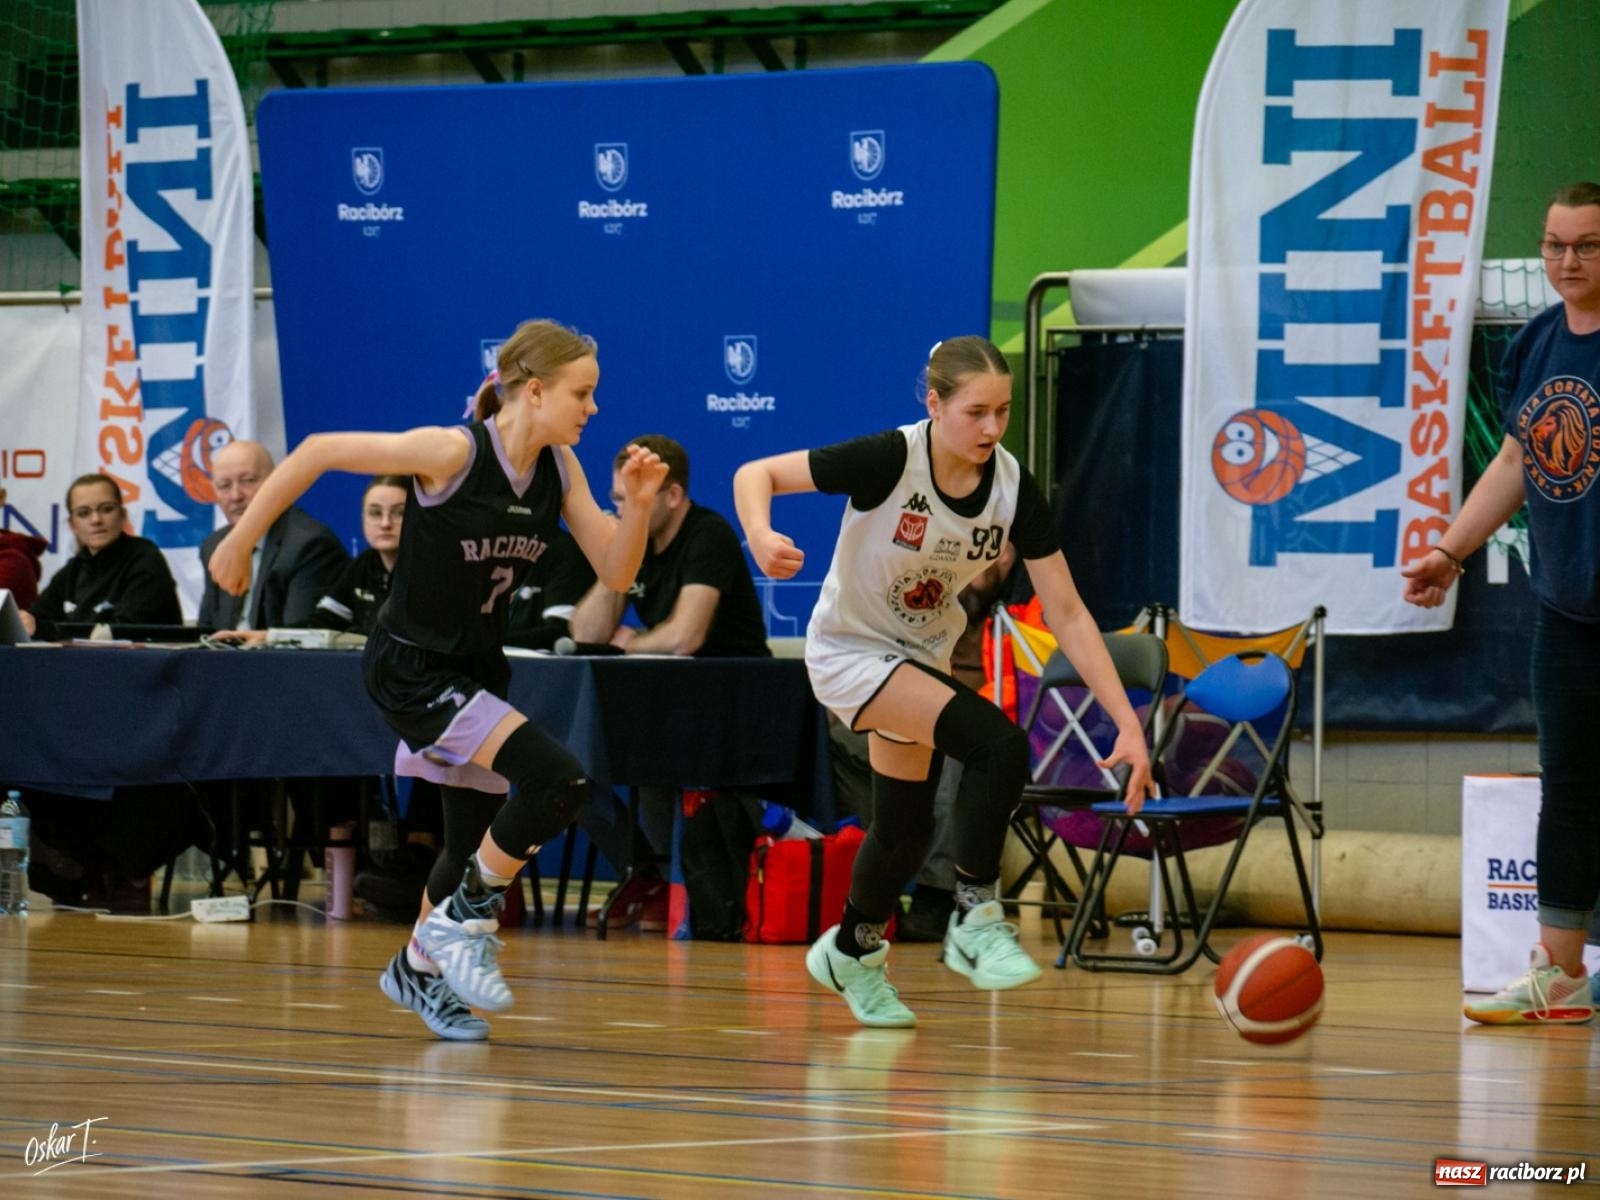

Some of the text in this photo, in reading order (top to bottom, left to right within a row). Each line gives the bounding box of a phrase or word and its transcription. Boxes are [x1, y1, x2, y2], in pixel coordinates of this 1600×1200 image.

[579, 199, 648, 218] Racibórz
[832, 187, 904, 209] Racibórz
[338, 203, 404, 221] Racibórz
[1249, 28, 1422, 568] MINI
[707, 392, 776, 411] Racibórz
[967, 524, 1004, 561] 99
[480, 565, 514, 614] 7
